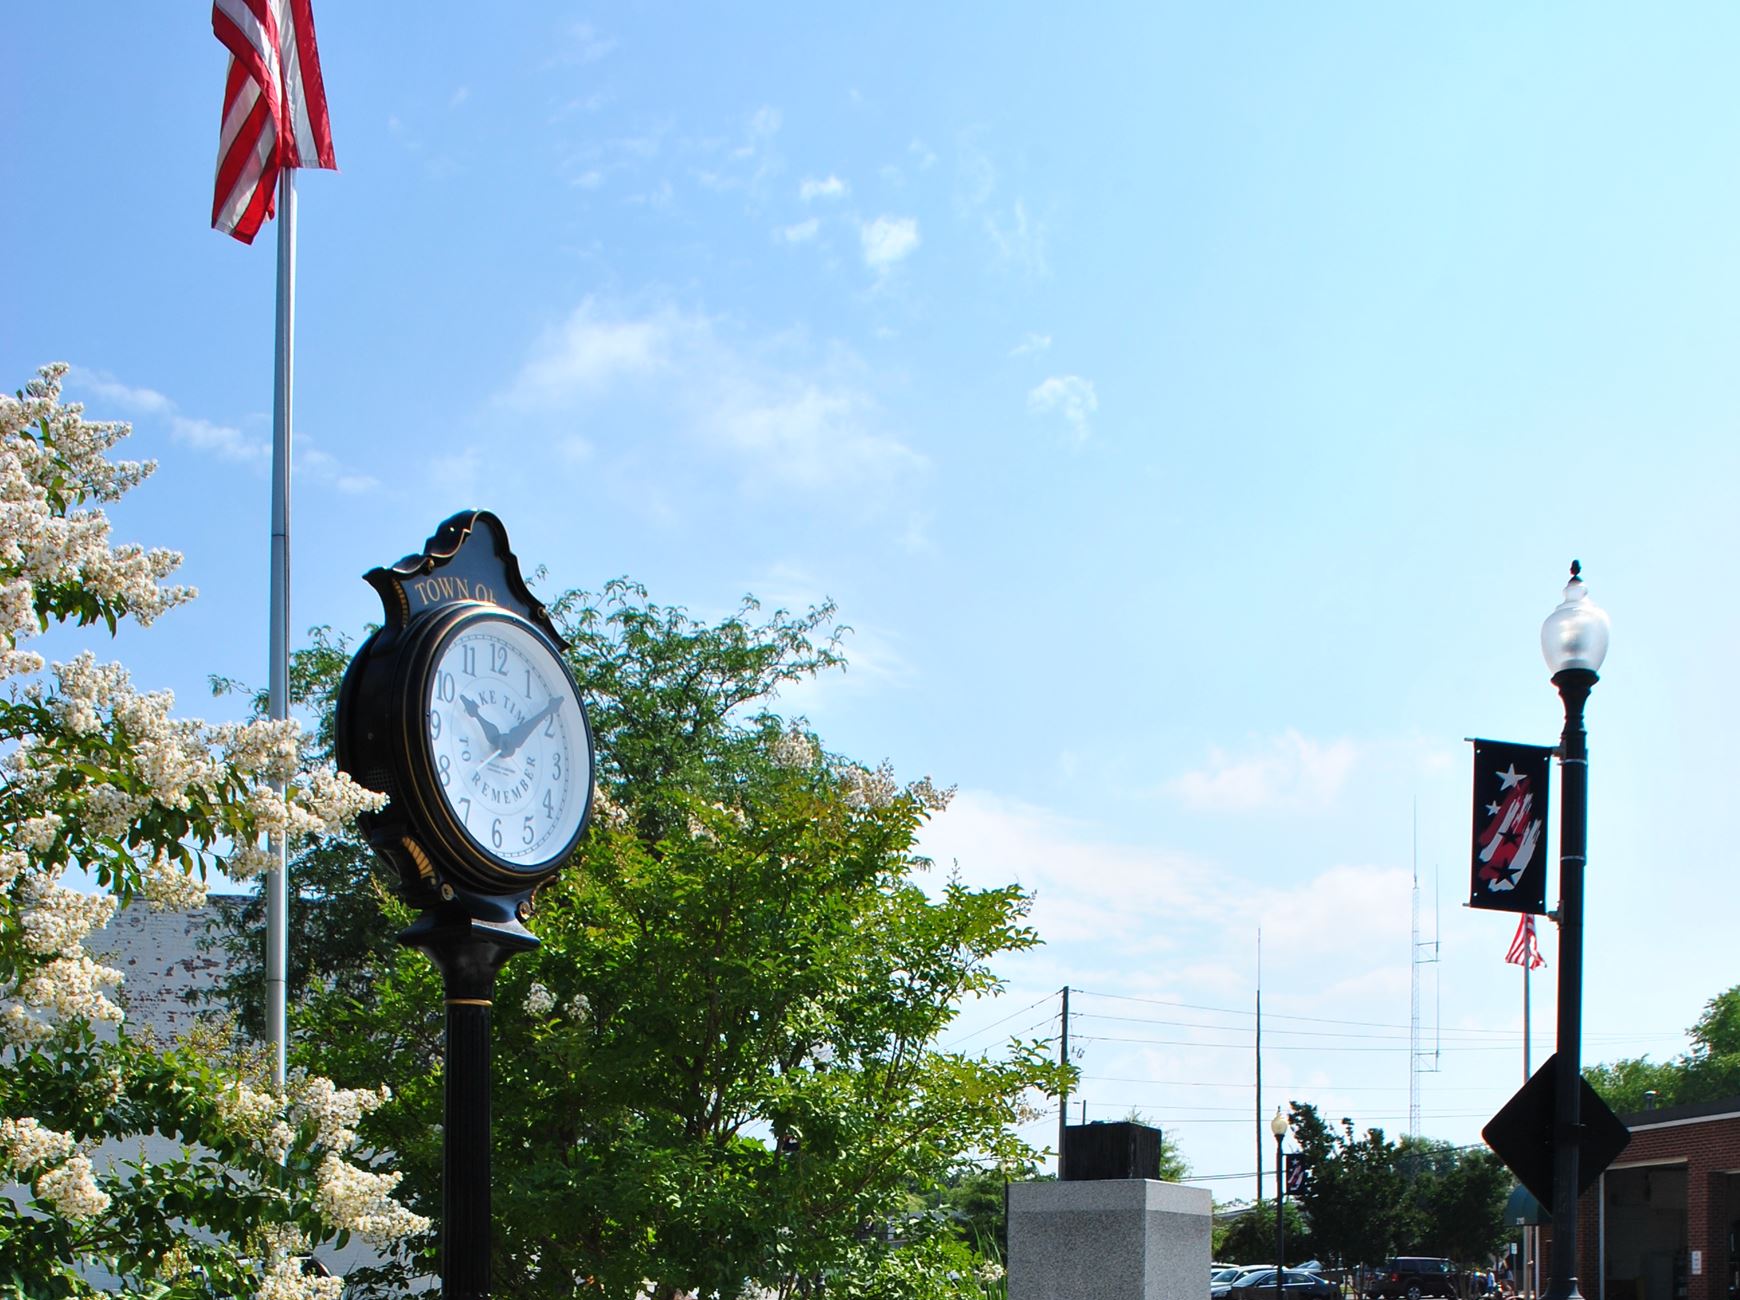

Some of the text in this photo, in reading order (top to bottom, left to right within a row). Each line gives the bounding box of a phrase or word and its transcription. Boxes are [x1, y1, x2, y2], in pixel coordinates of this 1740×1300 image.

[414, 577, 470, 605] TOWN
[461, 644, 477, 677] 11
[489, 643, 509, 677] 12
[436, 670, 455, 703] 10
[524, 669, 532, 700] 1
[430, 709, 442, 741] 9
[503, 695, 526, 724] TIM
[544, 711, 555, 739] 2
[459, 736, 472, 762] TO
[438, 754, 451, 788] 8
[471, 756, 536, 805] REMEMBER
[551, 752, 562, 782] 3
[458, 797, 471, 831] 7
[542, 788, 555, 820] 4
[491, 818, 503, 849] 6
[522, 815, 535, 846] 5
